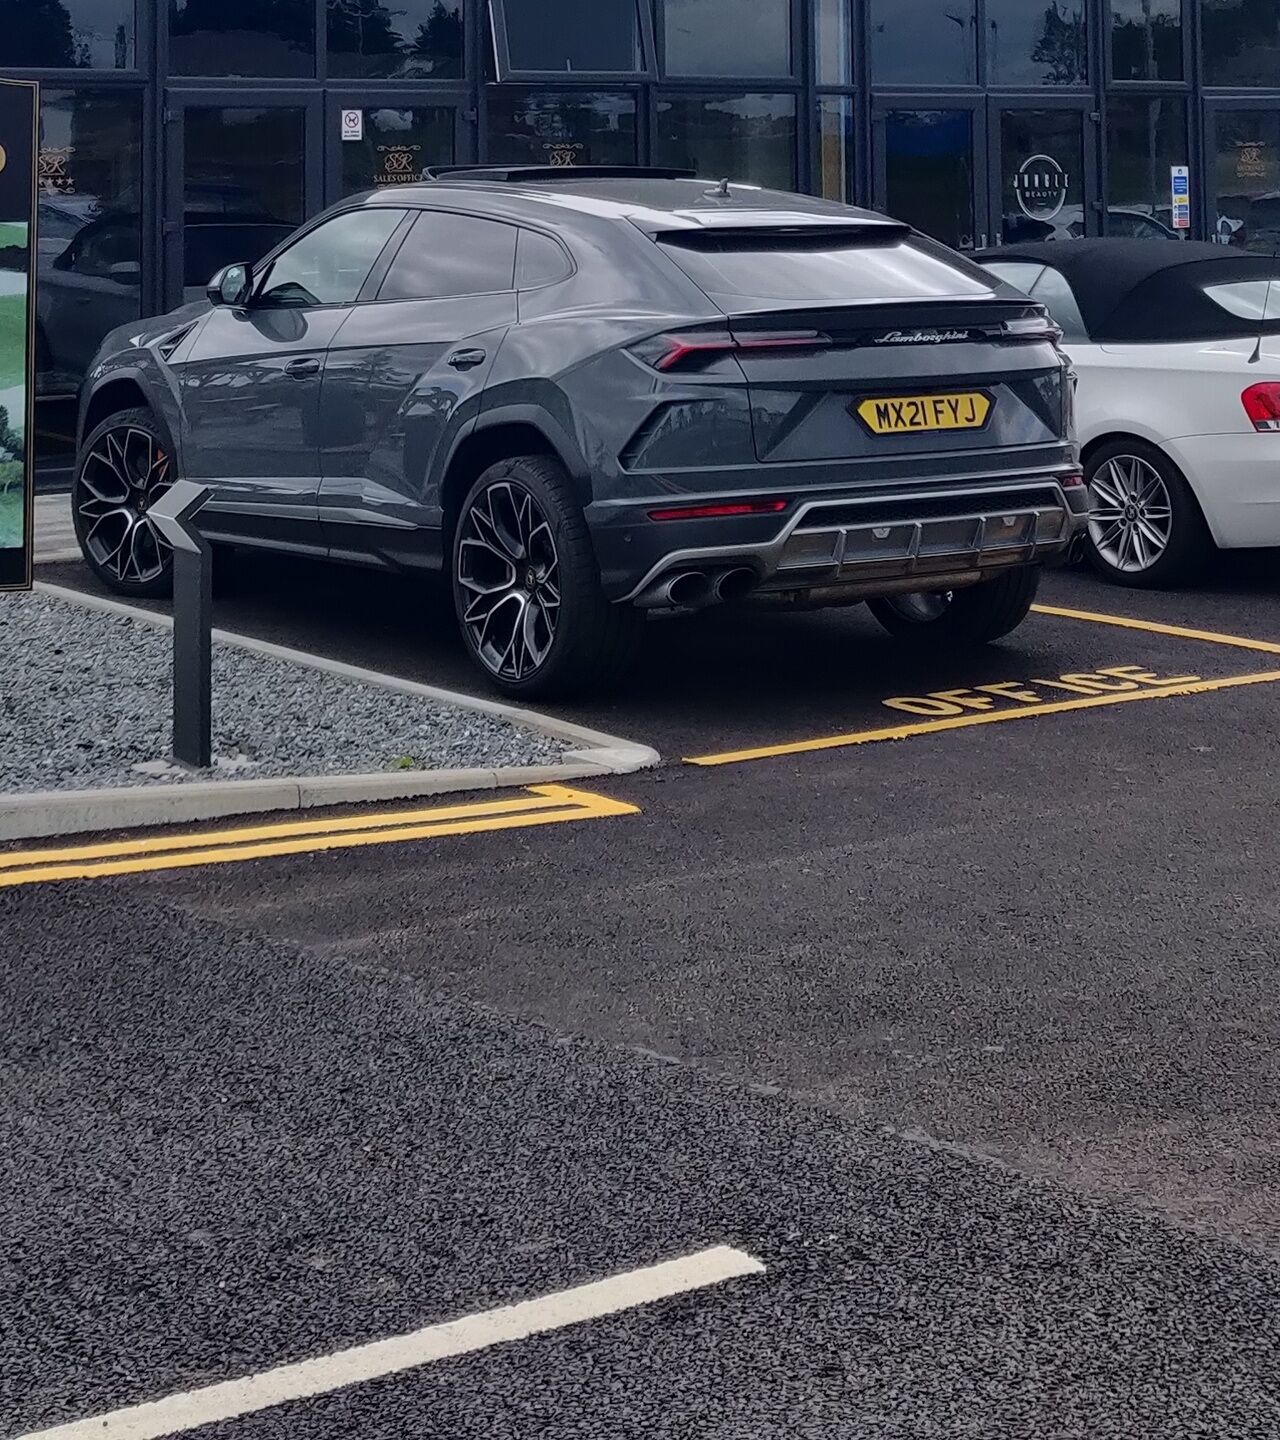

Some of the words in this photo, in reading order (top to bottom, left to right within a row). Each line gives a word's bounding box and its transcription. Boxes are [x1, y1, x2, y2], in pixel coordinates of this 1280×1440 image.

[373, 174, 398, 183] SALES
[873, 330, 969, 344] Lamborghini
[875, 400, 928, 429] MX21
[932, 398, 977, 425] FYJ
[880, 665, 1202, 717] OFFICE
